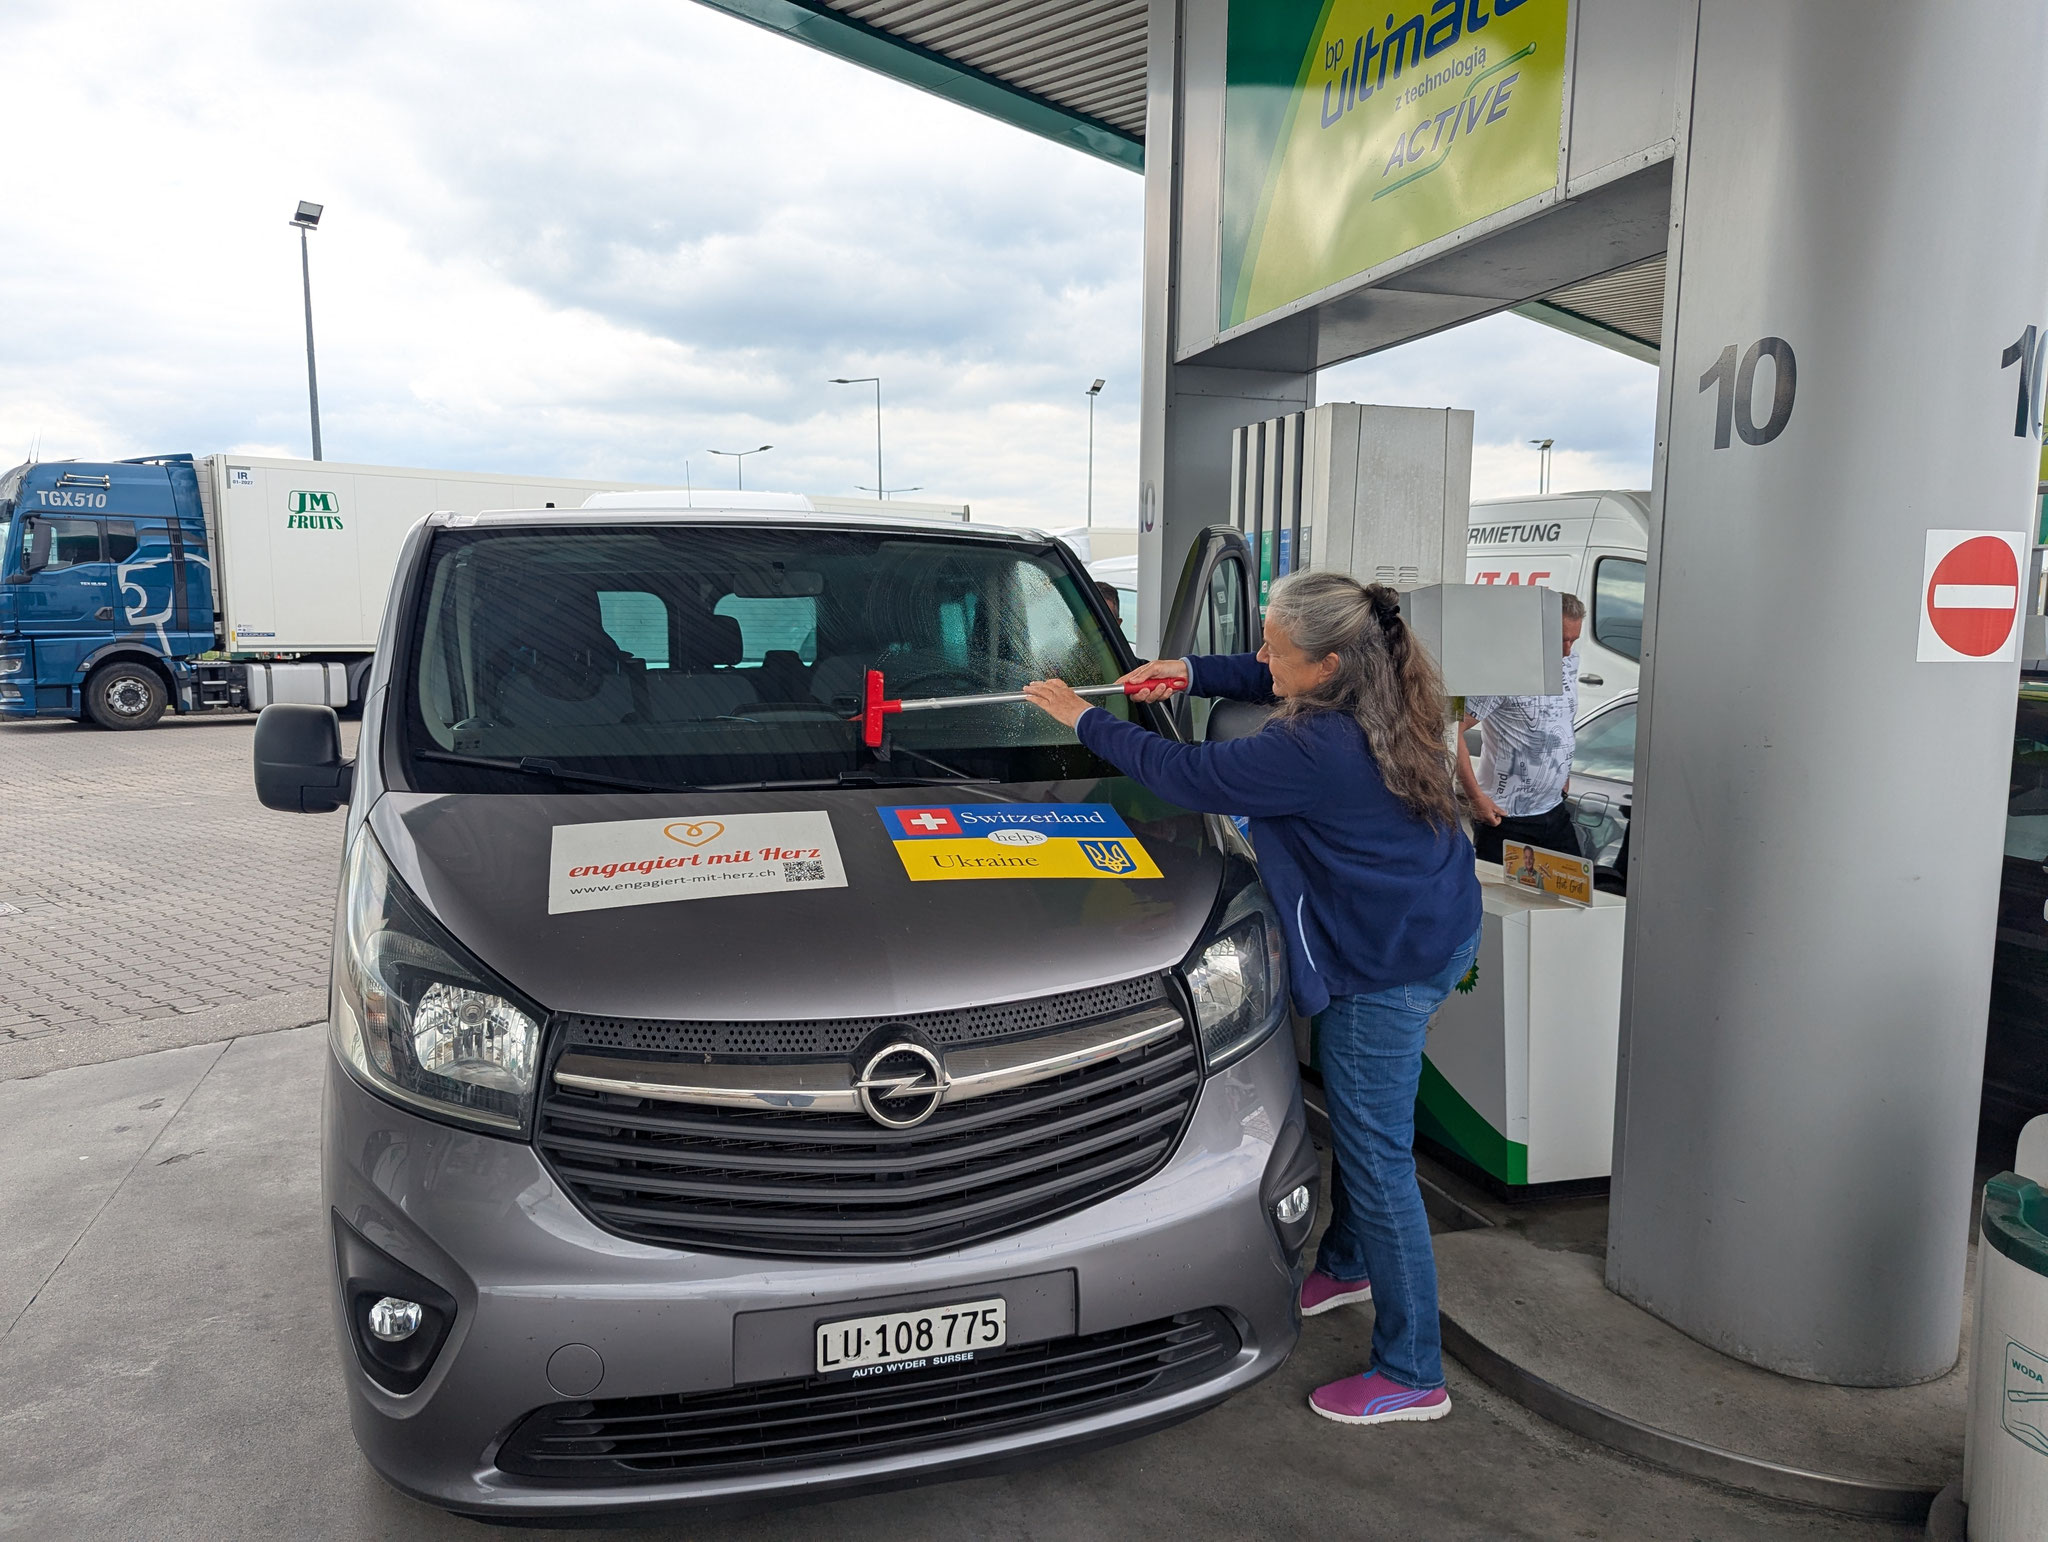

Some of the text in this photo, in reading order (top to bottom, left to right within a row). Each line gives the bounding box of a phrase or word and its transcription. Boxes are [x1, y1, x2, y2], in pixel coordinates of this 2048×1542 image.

[1320, 0, 1529, 129] ultima
[1325, 38, 1345, 71] bp
[1394, 45, 1487, 112] z technologią
[1382, 71, 1520, 177] ACTIVE
[1699, 336, 1797, 450] 10
[237, 471, 248, 480] IR
[295, 492, 332, 514] JM
[287, 514, 344, 530] FRUITS
[1467, 523, 1561, 544] RMIETUNG
[960, 811, 1107, 824] Switzerland
[994, 832, 1044, 845] helps
[568, 847, 822, 878] engagiert mit Herz
[929, 854, 1040, 868] Ukraine
[569, 869, 776, 895] www.engagiert-mit-herz.ch
[852, 1352, 974, 1378] AUTO WYDER SURSEE
[2012, 1359, 2044, 1384] WODA
